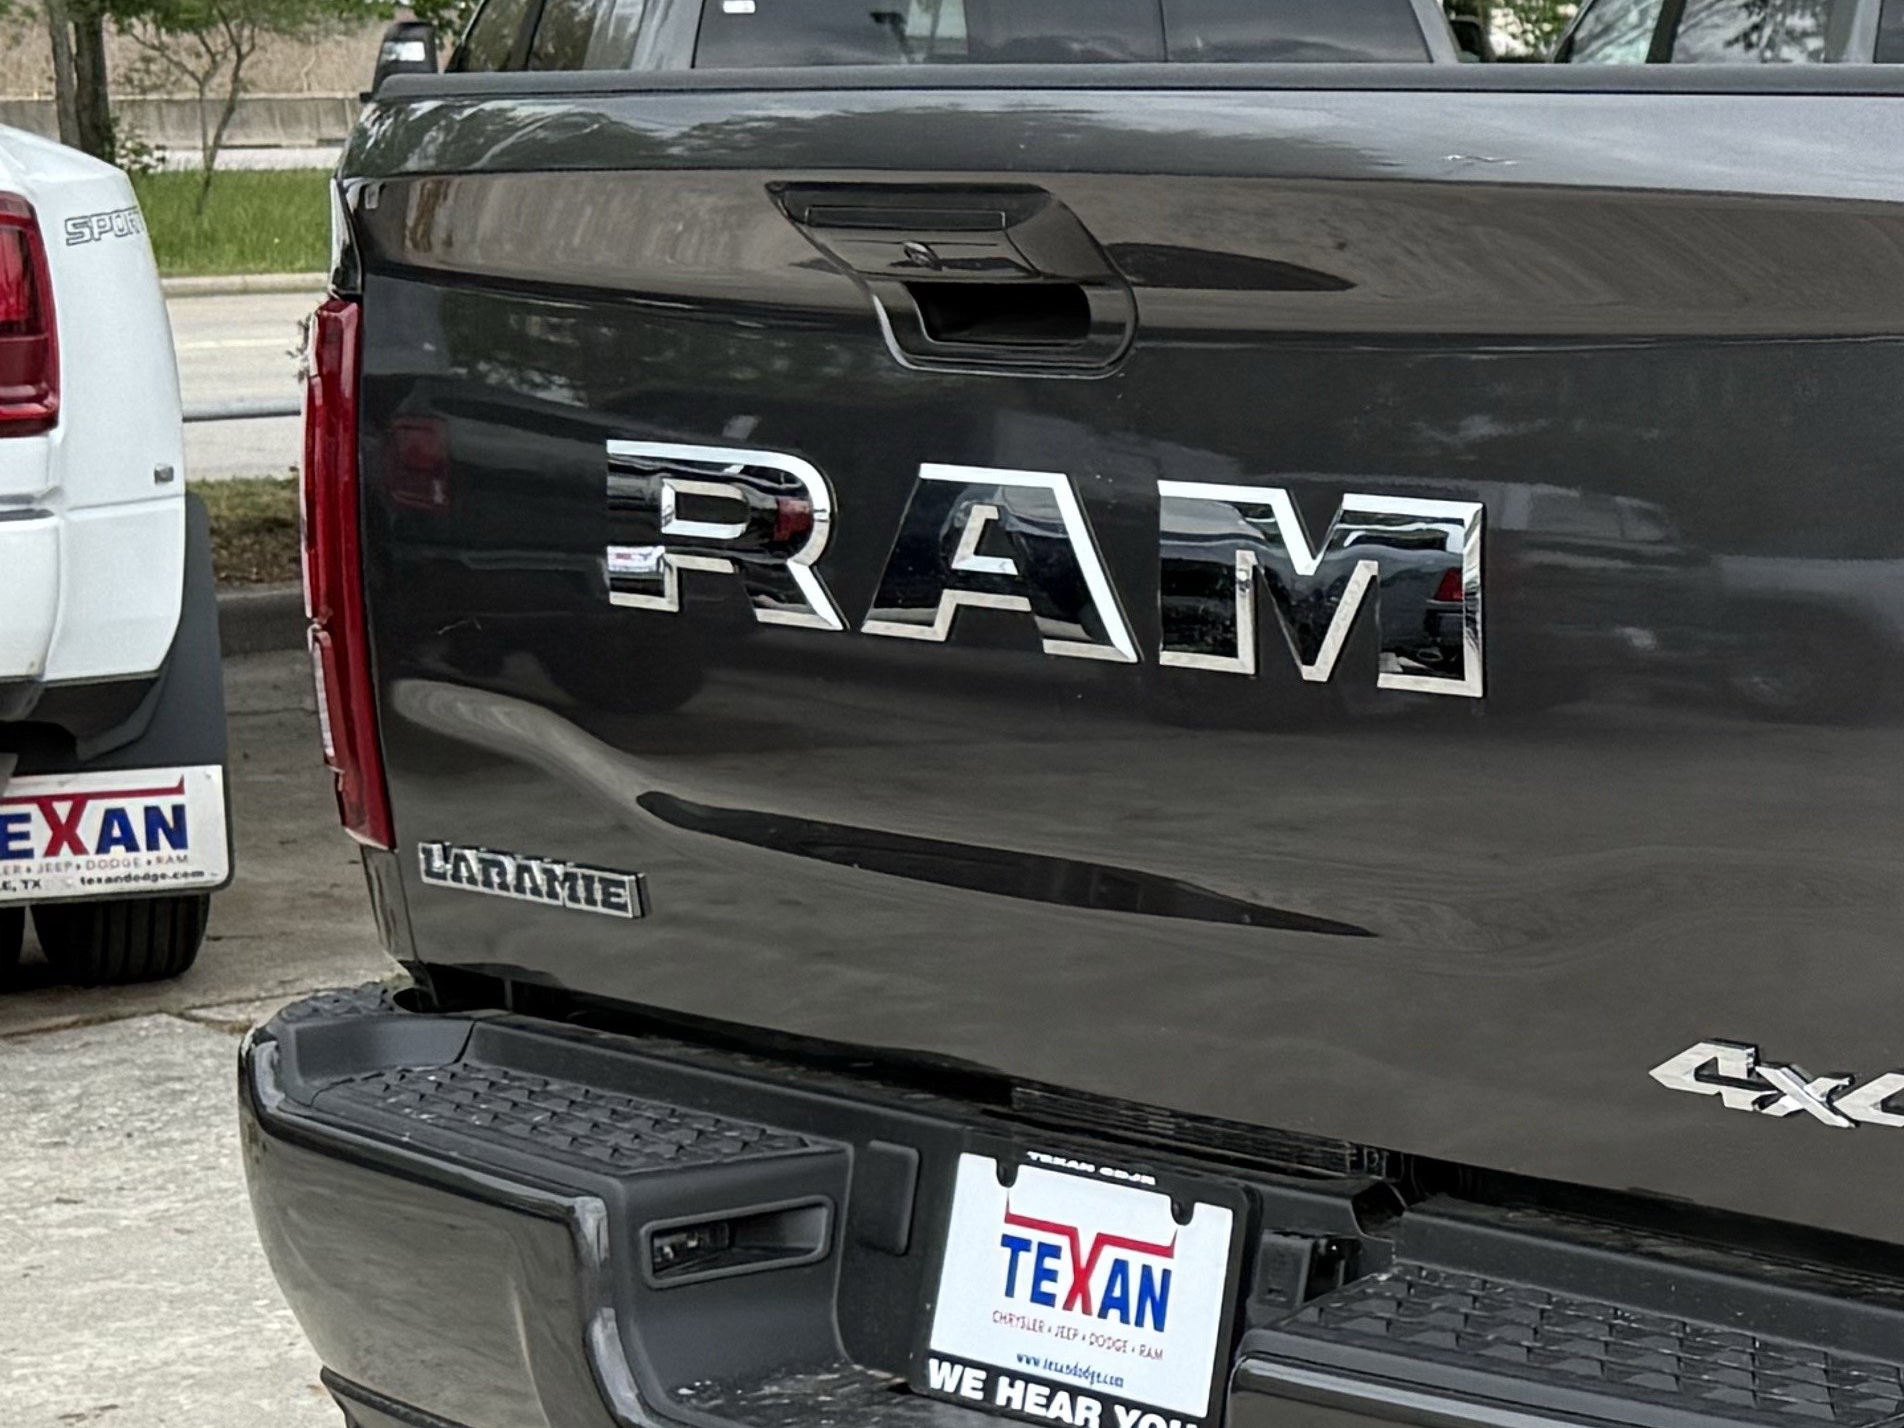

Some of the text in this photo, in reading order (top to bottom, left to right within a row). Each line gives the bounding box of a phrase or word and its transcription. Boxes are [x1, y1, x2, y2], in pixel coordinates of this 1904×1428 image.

[605, 439, 1484, 699] RAM
[0, 797, 189, 861] EXAN
[21, 878, 42, 890] TX
[417, 841, 642, 919] LARAMIE
[1000, 1227, 1173, 1333] TEXAN
[992, 1309, 1164, 1360] CHRYSLER JEEP DODGE RAM
[928, 1358, 987, 1401] WE
